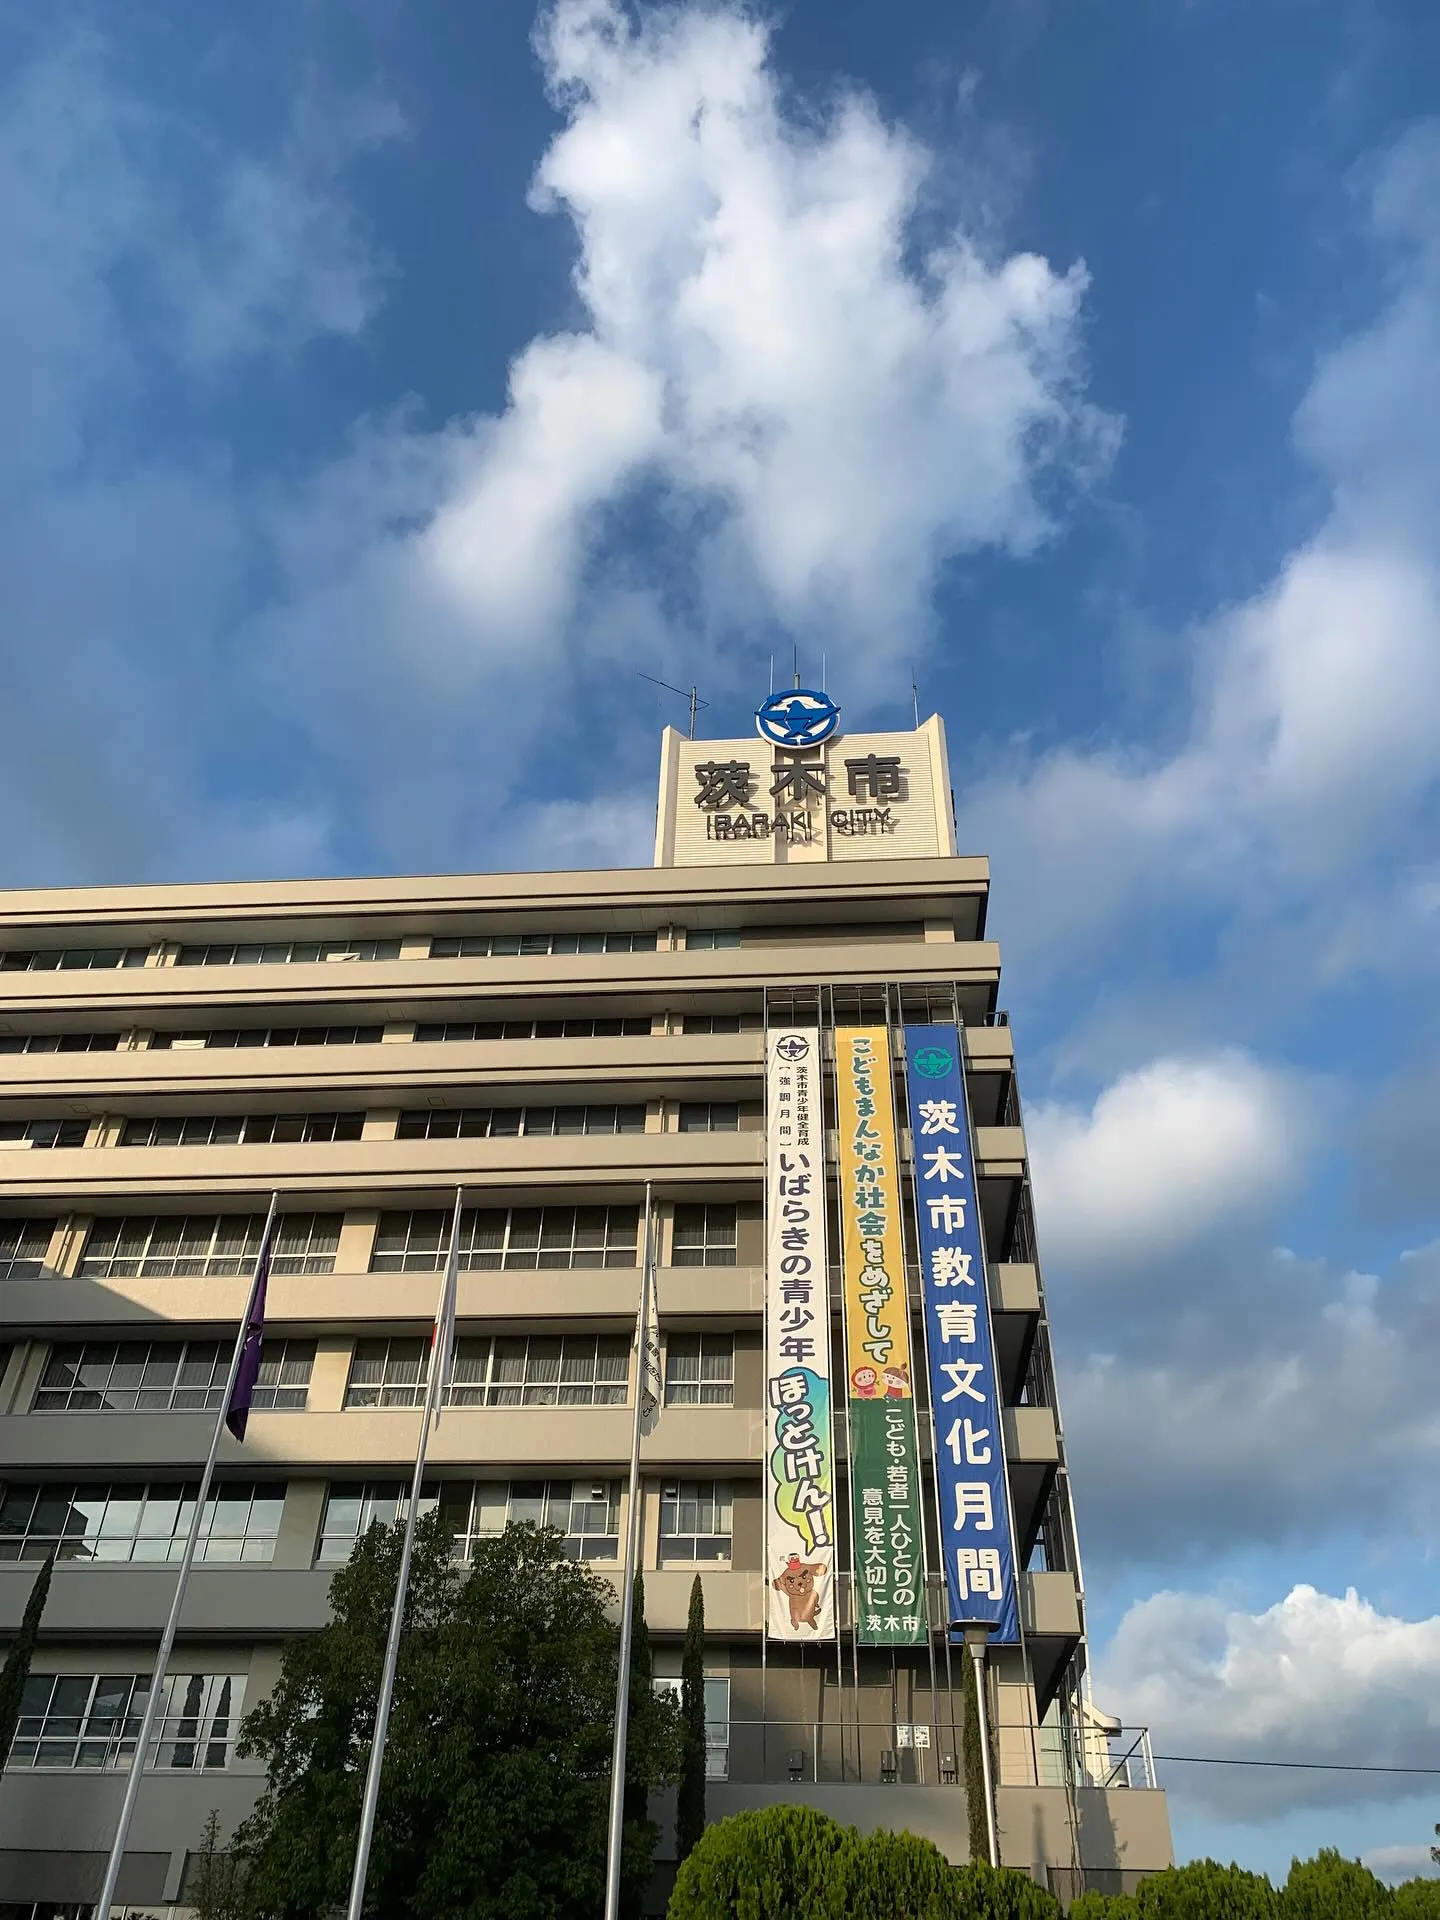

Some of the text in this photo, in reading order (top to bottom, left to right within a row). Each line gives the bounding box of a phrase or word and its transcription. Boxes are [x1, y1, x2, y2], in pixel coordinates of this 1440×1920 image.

[695, 754, 901, 804] 茨木市
[706, 808, 892, 833] IBARAKI CITY
[796, 1066, 810, 1146] 茨木市青少年健全育成
[778, 1152, 816, 1363] いばらきの青少年
[851, 1037, 894, 1365] こどもまんなか社会をめざして
[918, 1099, 1003, 1601] 茨木市教育文化月間
[769, 1372, 832, 1546] ほっとけん！
[885, 1408, 916, 1606] こども・若者一人ひとりの
[861, 1487, 889, 1606] 意見を大切に
[866, 1614, 919, 1632] 茨木市
